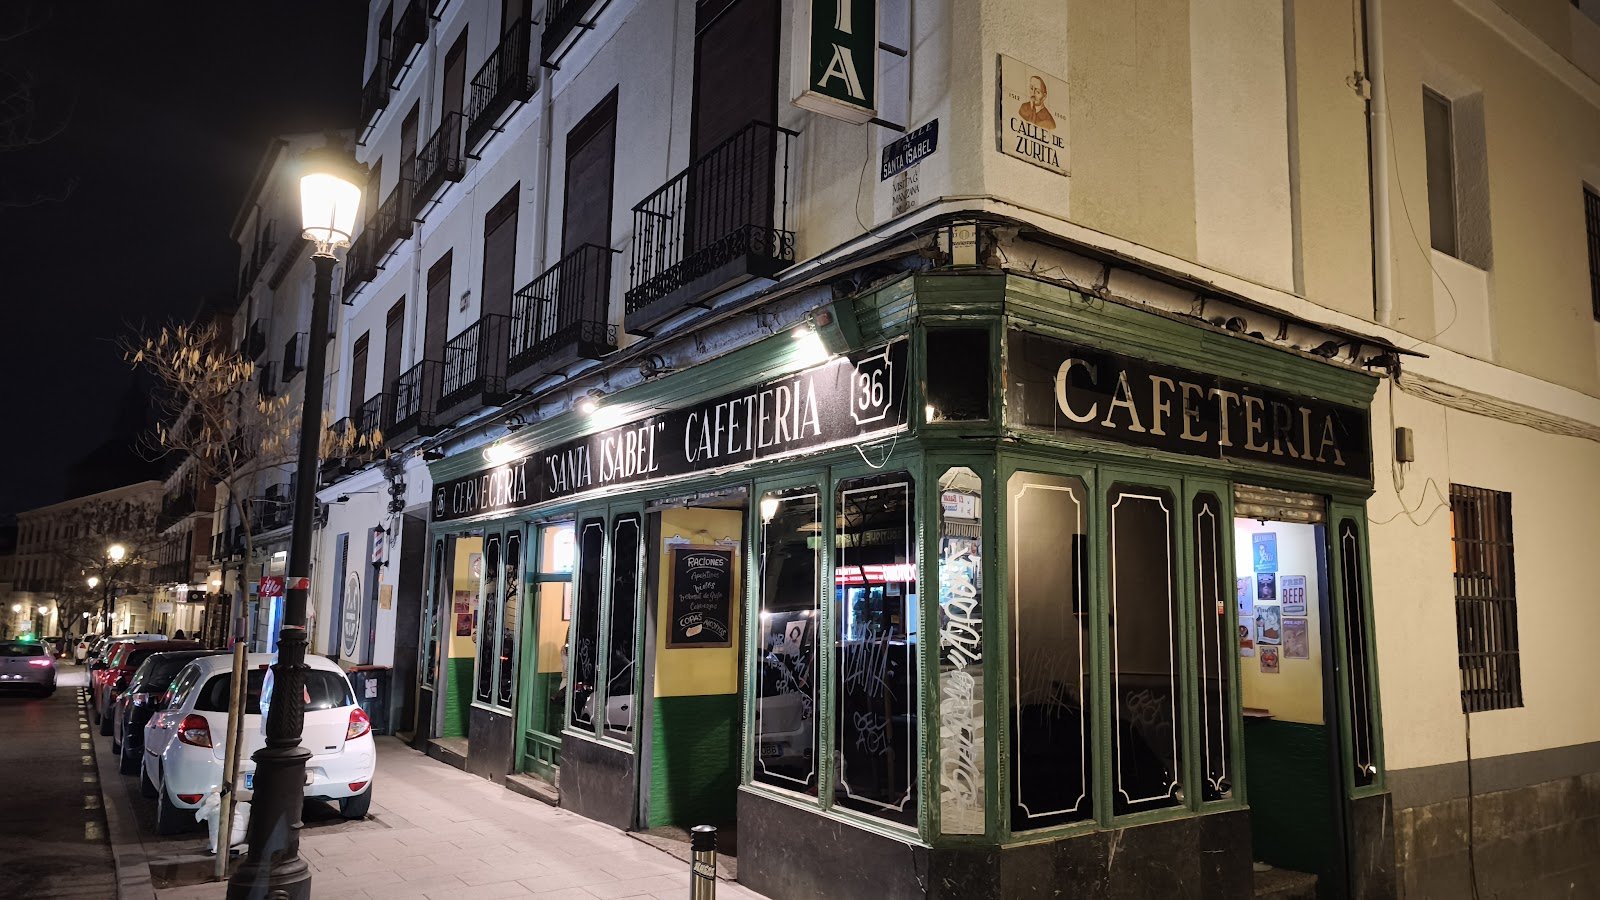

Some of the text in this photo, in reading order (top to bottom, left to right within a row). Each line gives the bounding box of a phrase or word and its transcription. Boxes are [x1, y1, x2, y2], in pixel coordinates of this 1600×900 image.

[903, 141, 912, 151] DE
[1010, 117, 1065, 149] CALLE DE
[883, 138, 932, 178] SANTA ISABEL
[1016, 135, 1060, 168] ZURITA
[1055, 358, 1346, 466] CAFETERIA
[453, 464, 527, 514] CERVECERIA
[545, 443, 592, 493] "SANTA
[599, 421, 665, 483] ISABEL"
[684, 375, 821, 463] CAFETERIA
[858, 369, 884, 411] 36
[688, 557, 724, 567] RACIONES
[1283, 587, 1304, 604] BEER
[679, 613, 703, 627] COPAS
